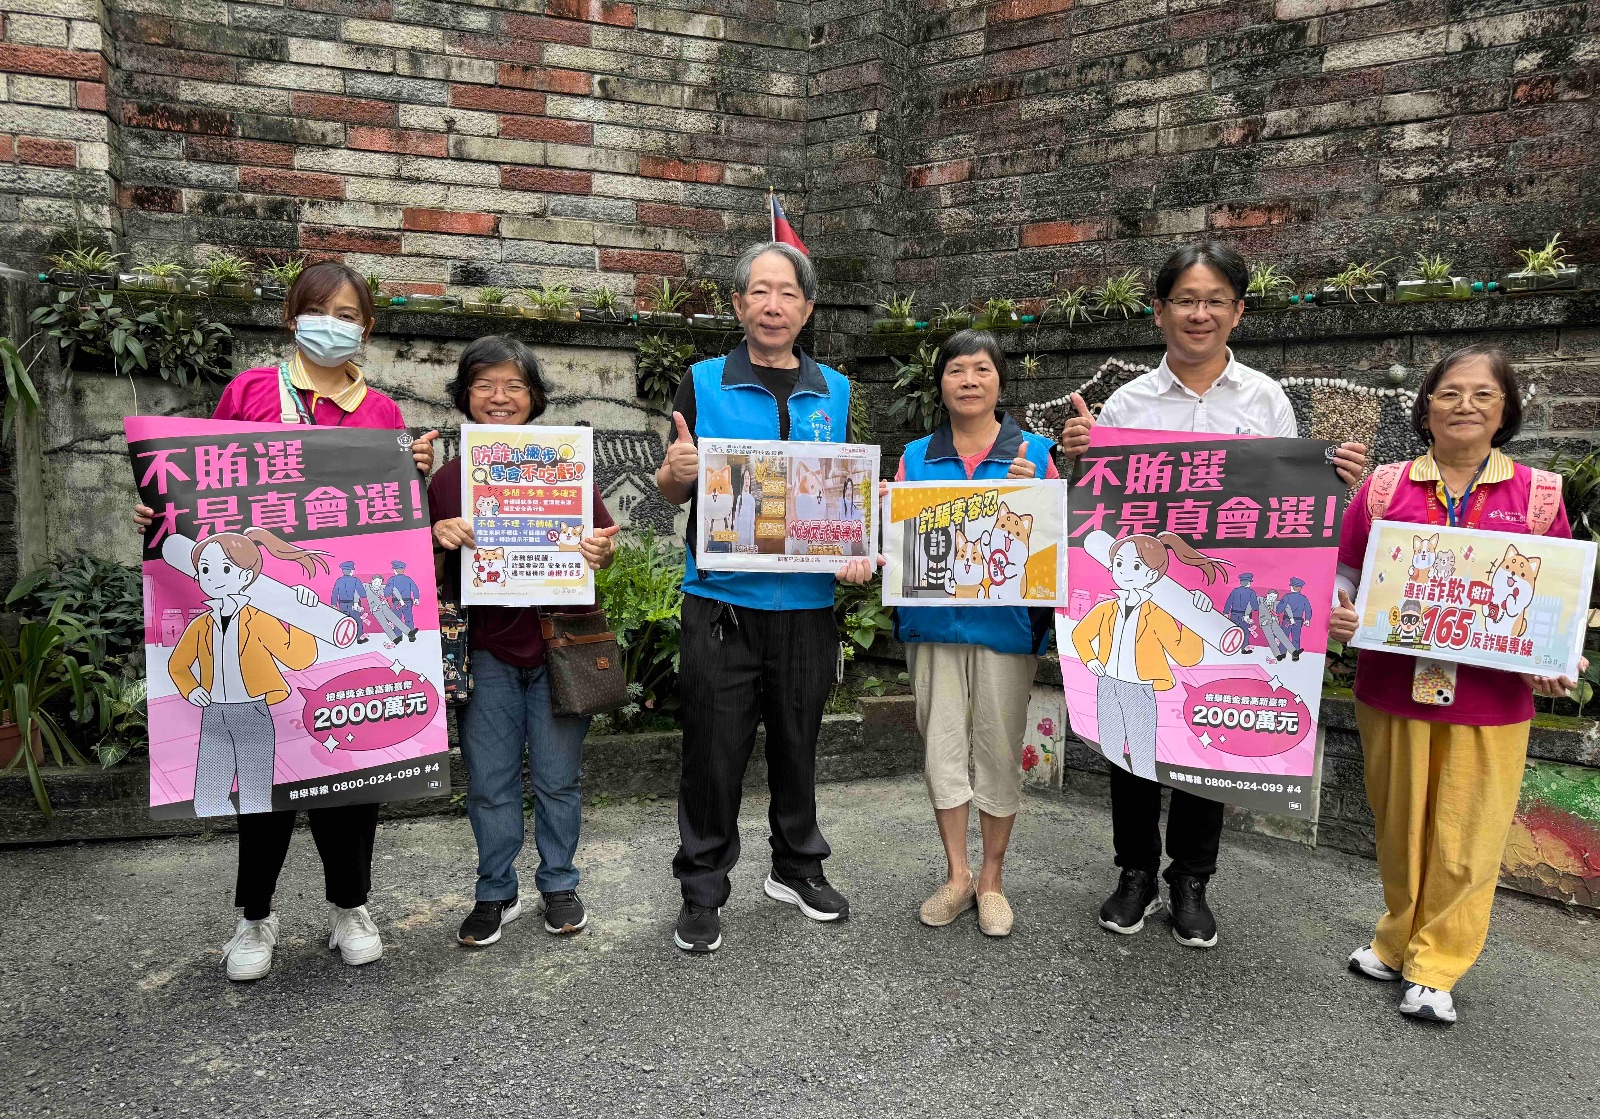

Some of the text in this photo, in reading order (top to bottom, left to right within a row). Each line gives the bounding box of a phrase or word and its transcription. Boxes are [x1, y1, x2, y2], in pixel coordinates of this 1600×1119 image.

[137, 439, 306, 495] 不賄選
[472, 442, 557, 465] 防詐小撇步
[490, 462, 585, 484] 學會不吃虧!
[1075, 450, 1227, 496] 不賄選
[148, 479, 424, 549] 才是真會選!
[918, 488, 999, 534] 詐騙零容忍
[1068, 495, 1338, 541] 才是真會選!
[929, 530, 946, 556] 詐
[1403, 575, 1490, 605] 遇到詐欺 撥打
[1421, 604, 1534, 658] 165 反詐騙專線
[313, 693, 429, 732] 2000萬元
[1192, 706, 1300, 736] 2000萬元
[288, 784, 330, 801] 檢舉專線
[332, 767, 421, 793] 0800-024-099
[424, 762, 440, 774] #4
[1169, 771, 1302, 795] 檢舉專線 0800-024-099 #4
